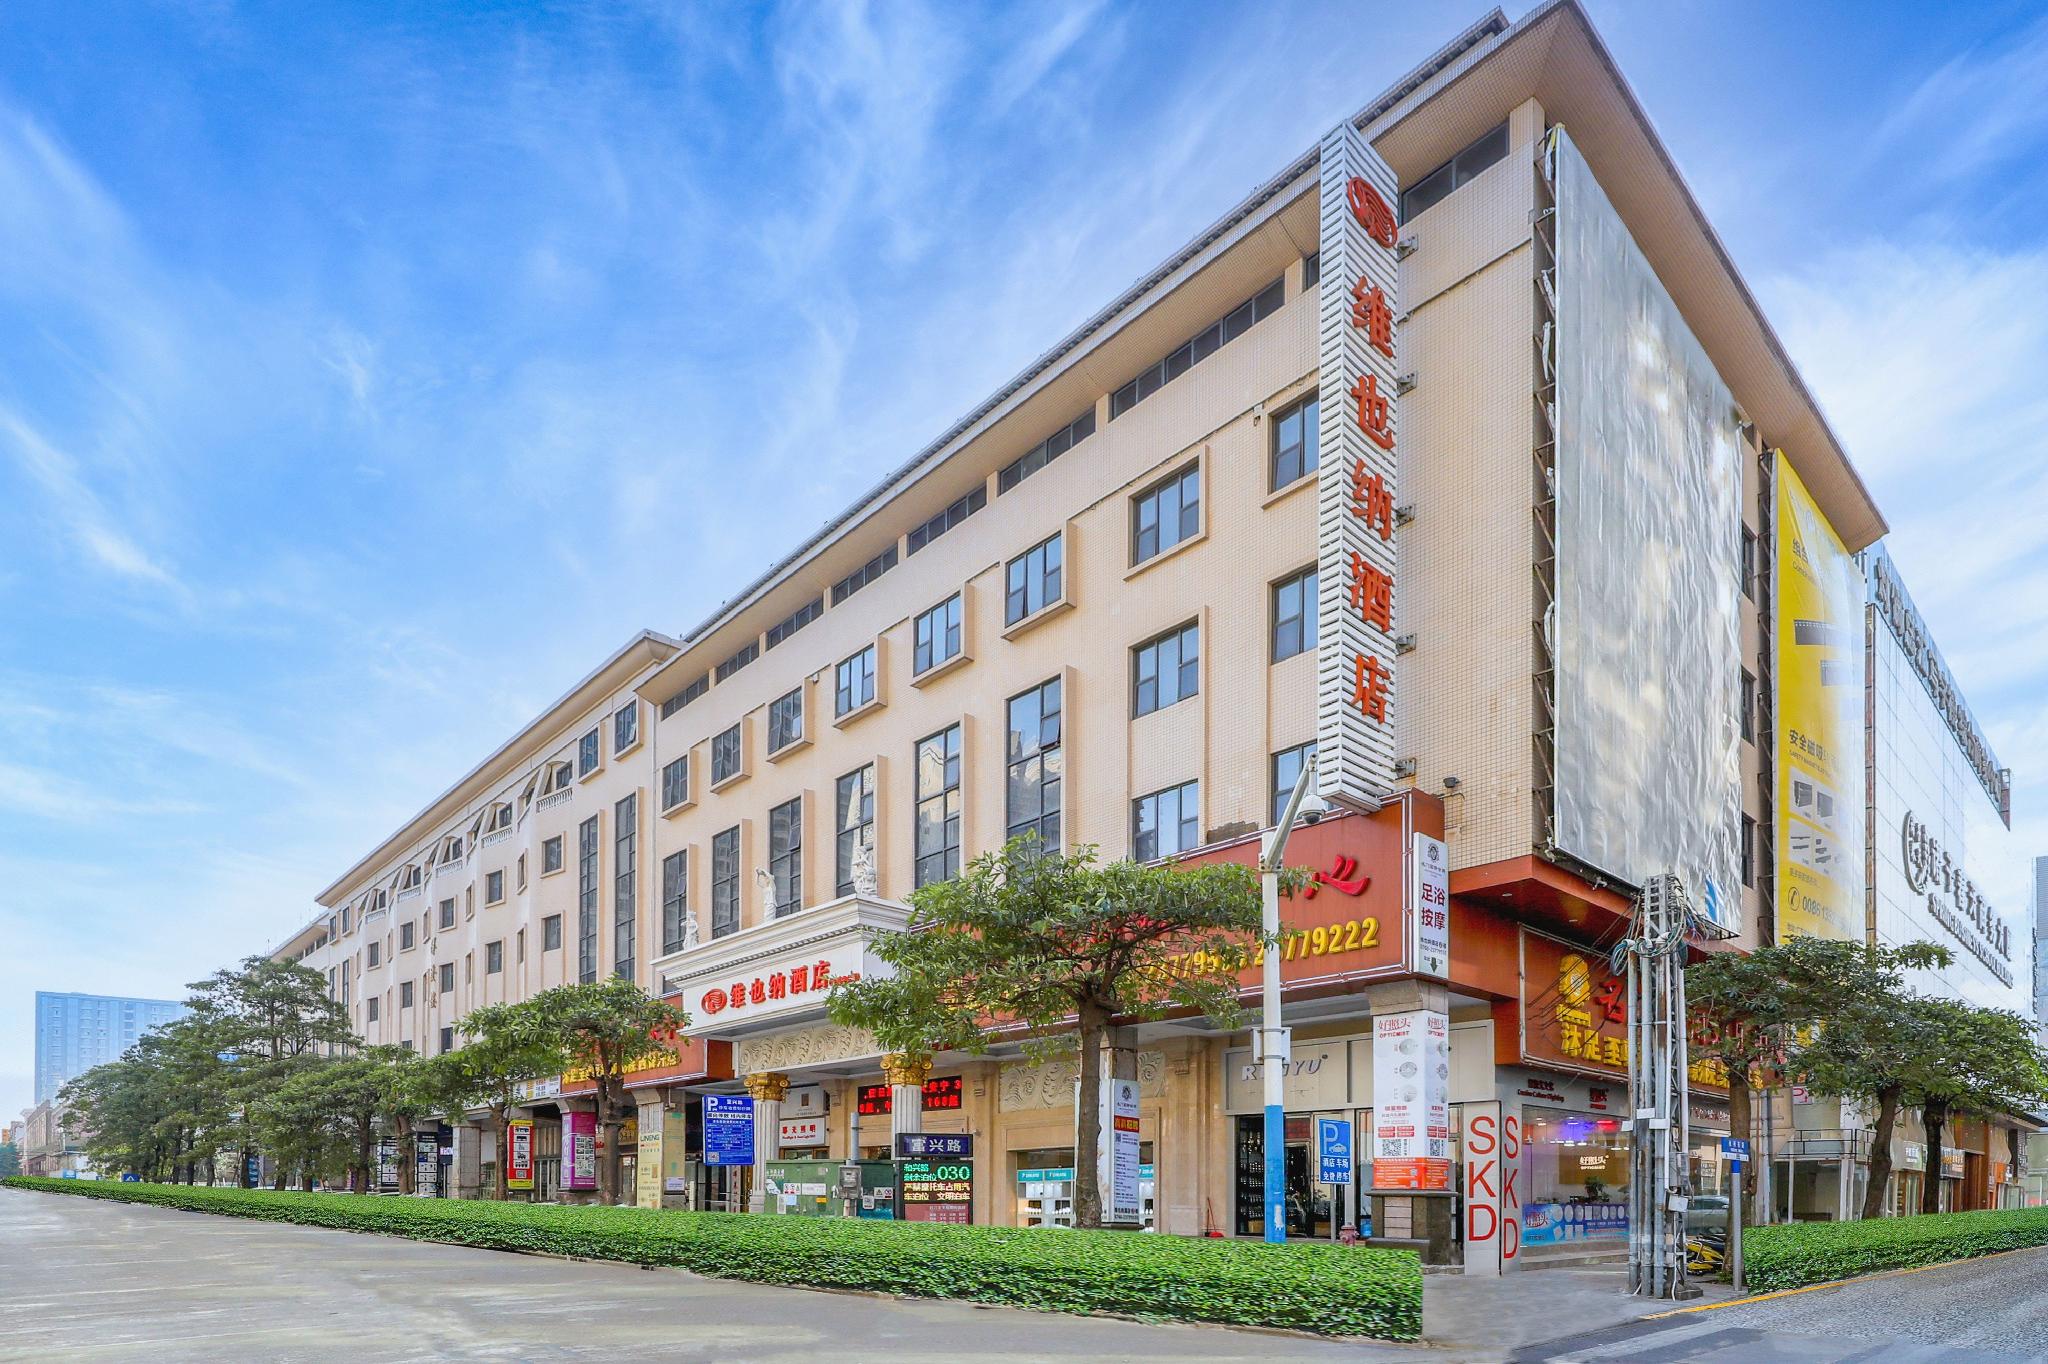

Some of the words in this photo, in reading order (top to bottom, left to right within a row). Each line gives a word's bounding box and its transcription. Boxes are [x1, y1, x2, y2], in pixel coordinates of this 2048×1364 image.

[1351, 274, 1394, 725] 维也纳酒店
[1421, 883, 1446, 906] 足浴
[1421, 907, 1446, 930] 按摩
[730, 960, 831, 1008] 维也纳酒店
[911, 1138, 962, 1152] 富兴路
[1323, 1123, 1339, 1155] P
[937, 1166, 970, 1180] 030
[1468, 1116, 1497, 1242] SKD
[1504, 1116, 1519, 1260] SKD
